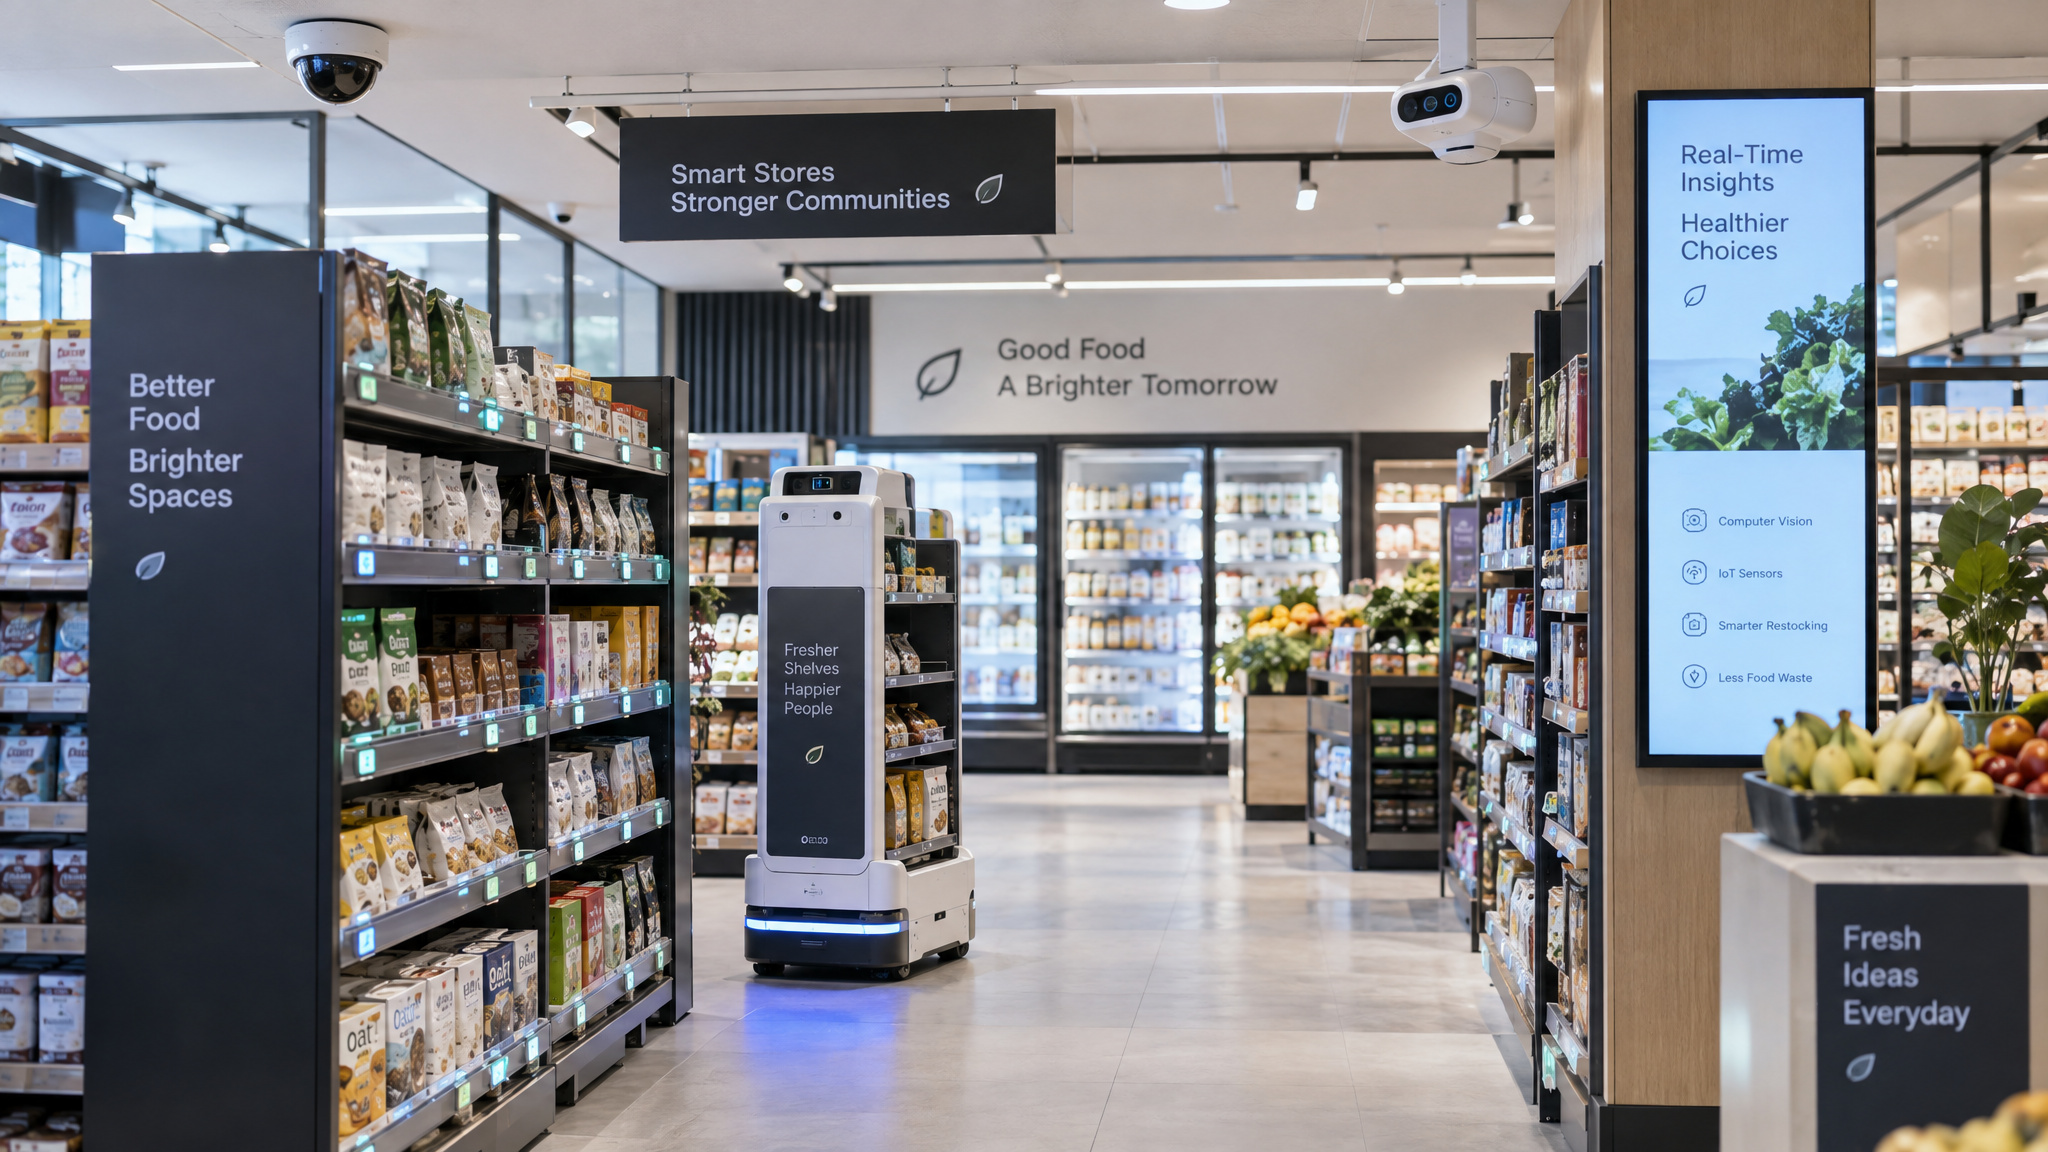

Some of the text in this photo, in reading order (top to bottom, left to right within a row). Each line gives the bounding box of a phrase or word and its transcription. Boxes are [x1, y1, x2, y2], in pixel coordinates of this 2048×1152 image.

[1681, 143, 1804, 165] Real-Time
[671, 162, 835, 185] Smart Stores
[1681, 171, 1775, 198] Insights
[670, 187, 951, 217] Stronger Communities
[1681, 212, 1790, 233] Healthier
[1681, 239, 1778, 261] Choices
[997, 337, 1145, 361] Good Food
[129, 372, 216, 398] Better
[997, 373, 1279, 402] A Brighter Tomorrow
[129, 405, 200, 431] Food
[129, 447, 244, 479] Brighter
[128, 482, 233, 514] Spaces
[1718, 516, 1813, 529] Computer Vision
[1718, 568, 1783, 579] IoT Sensors
[1718, 620, 1829, 633] Smarter Restocking
[784, 642, 839, 657] Fresher
[784, 661, 840, 675] Shelves
[1718, 672, 1813, 683] Less Food Waste
[784, 682, 842, 699] Happier
[784, 701, 833, 719] People
[1843, 924, 1922, 951] Fresh
[1843, 961, 1920, 988] Ideas
[1843, 999, 1971, 1032] Everyday
